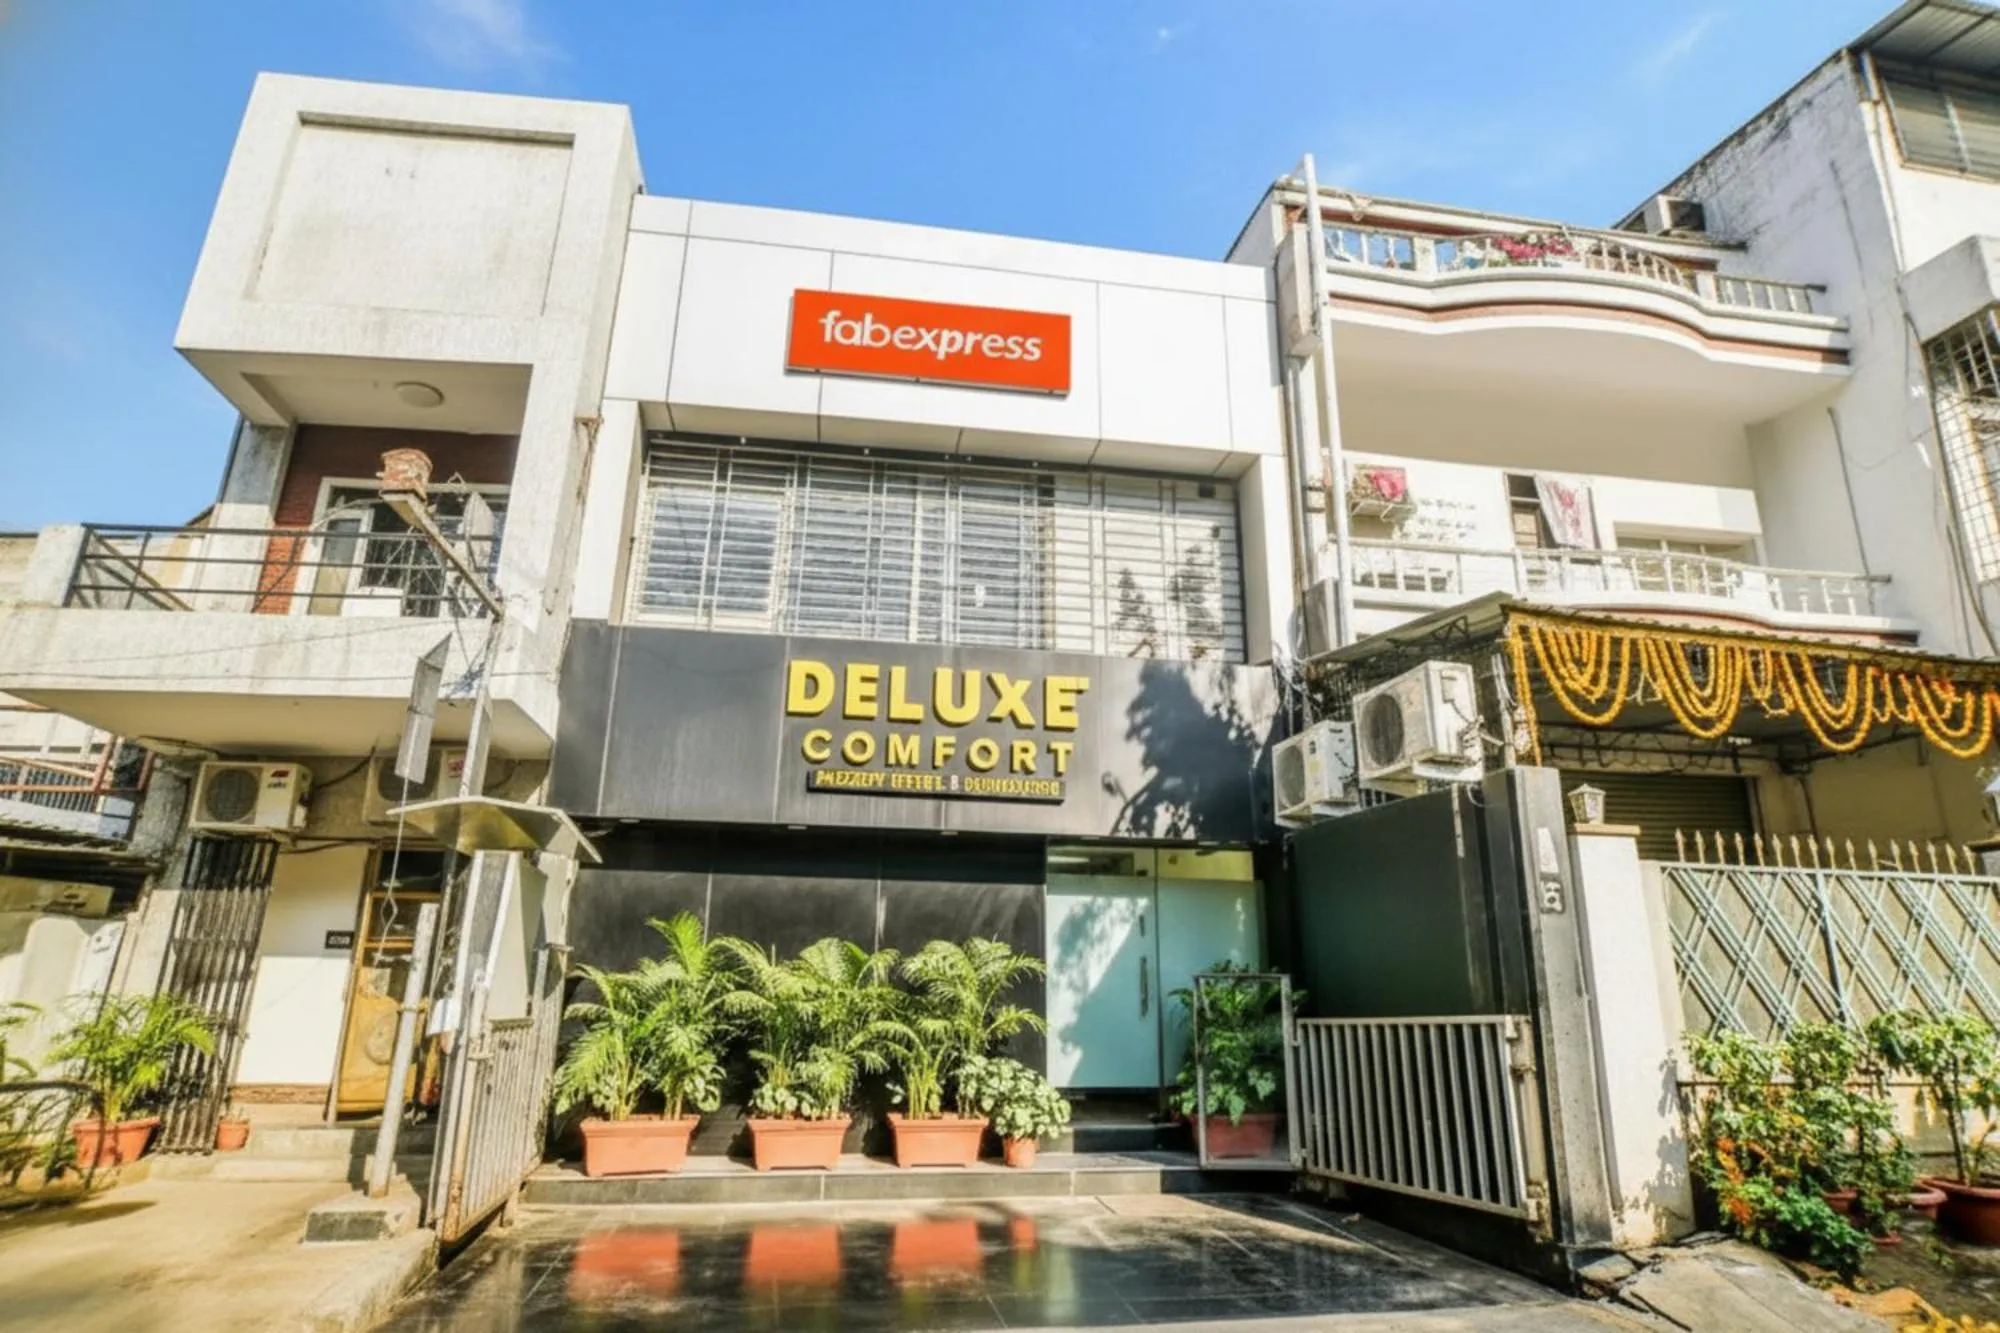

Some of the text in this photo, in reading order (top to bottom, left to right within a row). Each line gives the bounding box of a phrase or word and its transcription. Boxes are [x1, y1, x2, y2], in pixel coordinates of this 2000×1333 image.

[819, 310, 1042, 361] fabexpress
[786, 660, 1089, 729] DELUXE
[802, 729, 1074, 774] COMFORT
